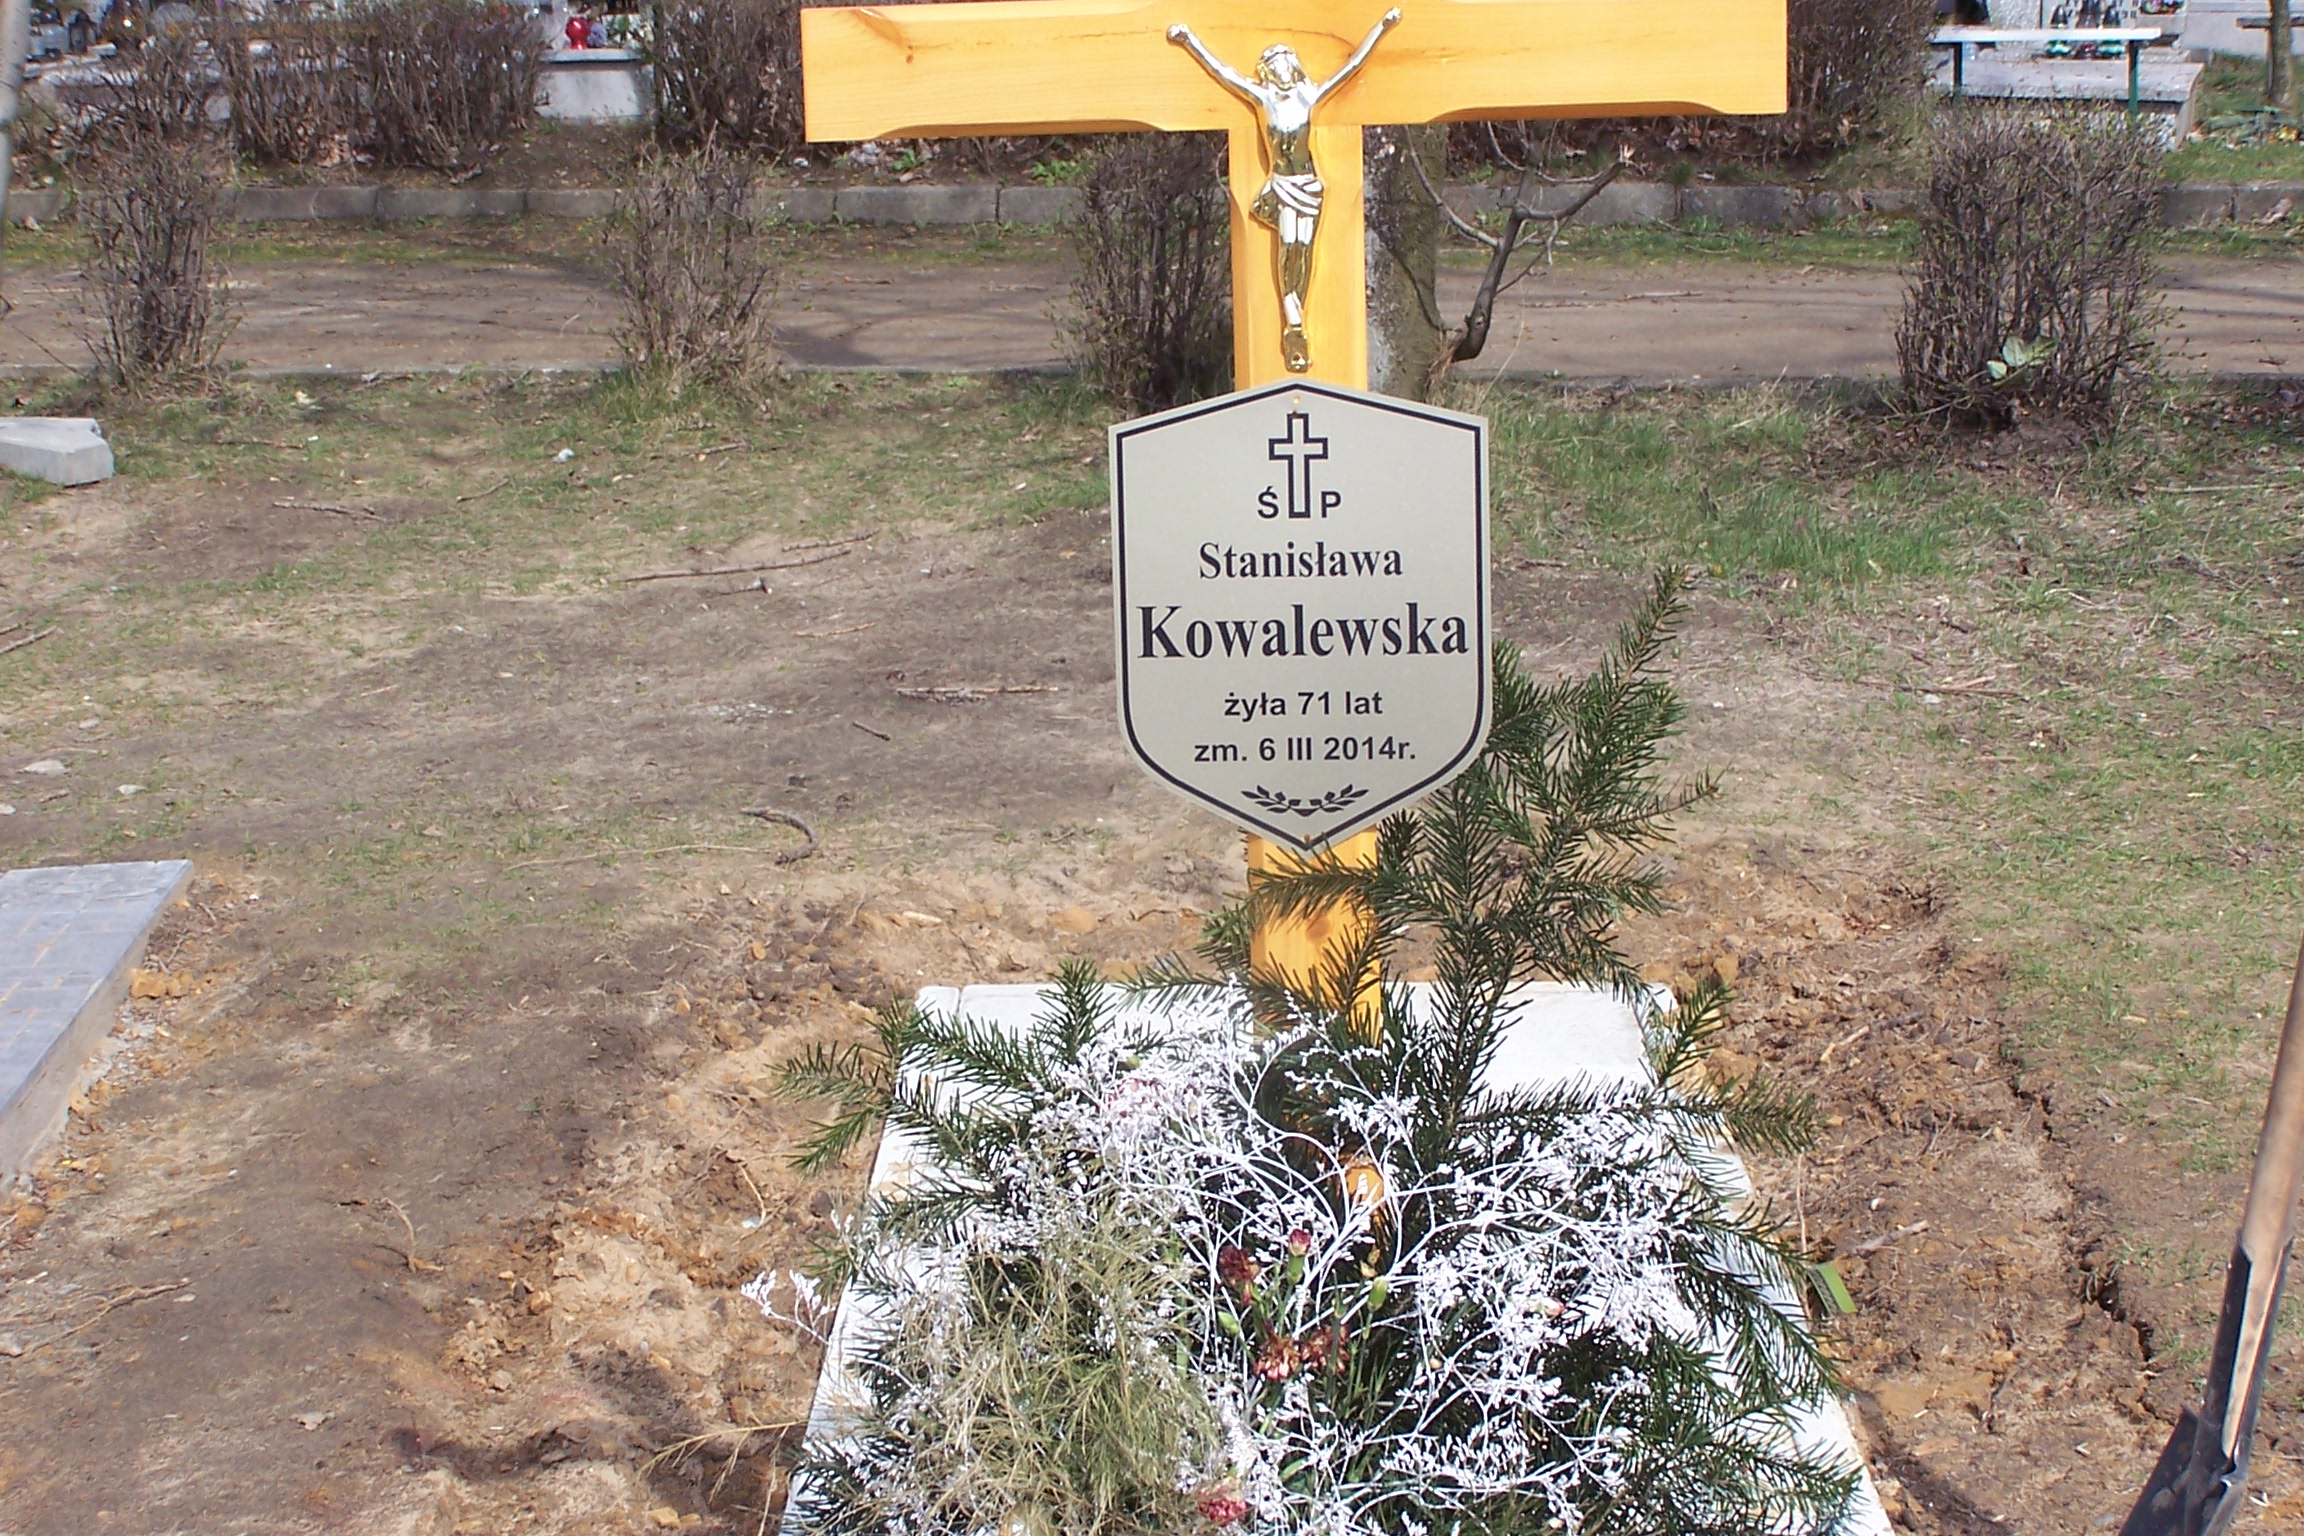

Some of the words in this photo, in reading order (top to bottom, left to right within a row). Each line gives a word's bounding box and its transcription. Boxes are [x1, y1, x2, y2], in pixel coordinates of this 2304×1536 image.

[1257, 485, 1279, 519] Ś
[1321, 491, 1341, 518] P
[1200, 541, 1403, 579] Stanisława
[1137, 602, 1469, 659] Kowalewska
[1224, 691, 1286, 723] żyła
[1297, 691, 1330, 715] 71
[1345, 691, 1383, 715] lat
[1194, 744, 1248, 762] zm.
[1259, 737, 1276, 761] 6
[1287, 737, 1312, 761] III
[1323, 735, 1416, 761] 2014r.
